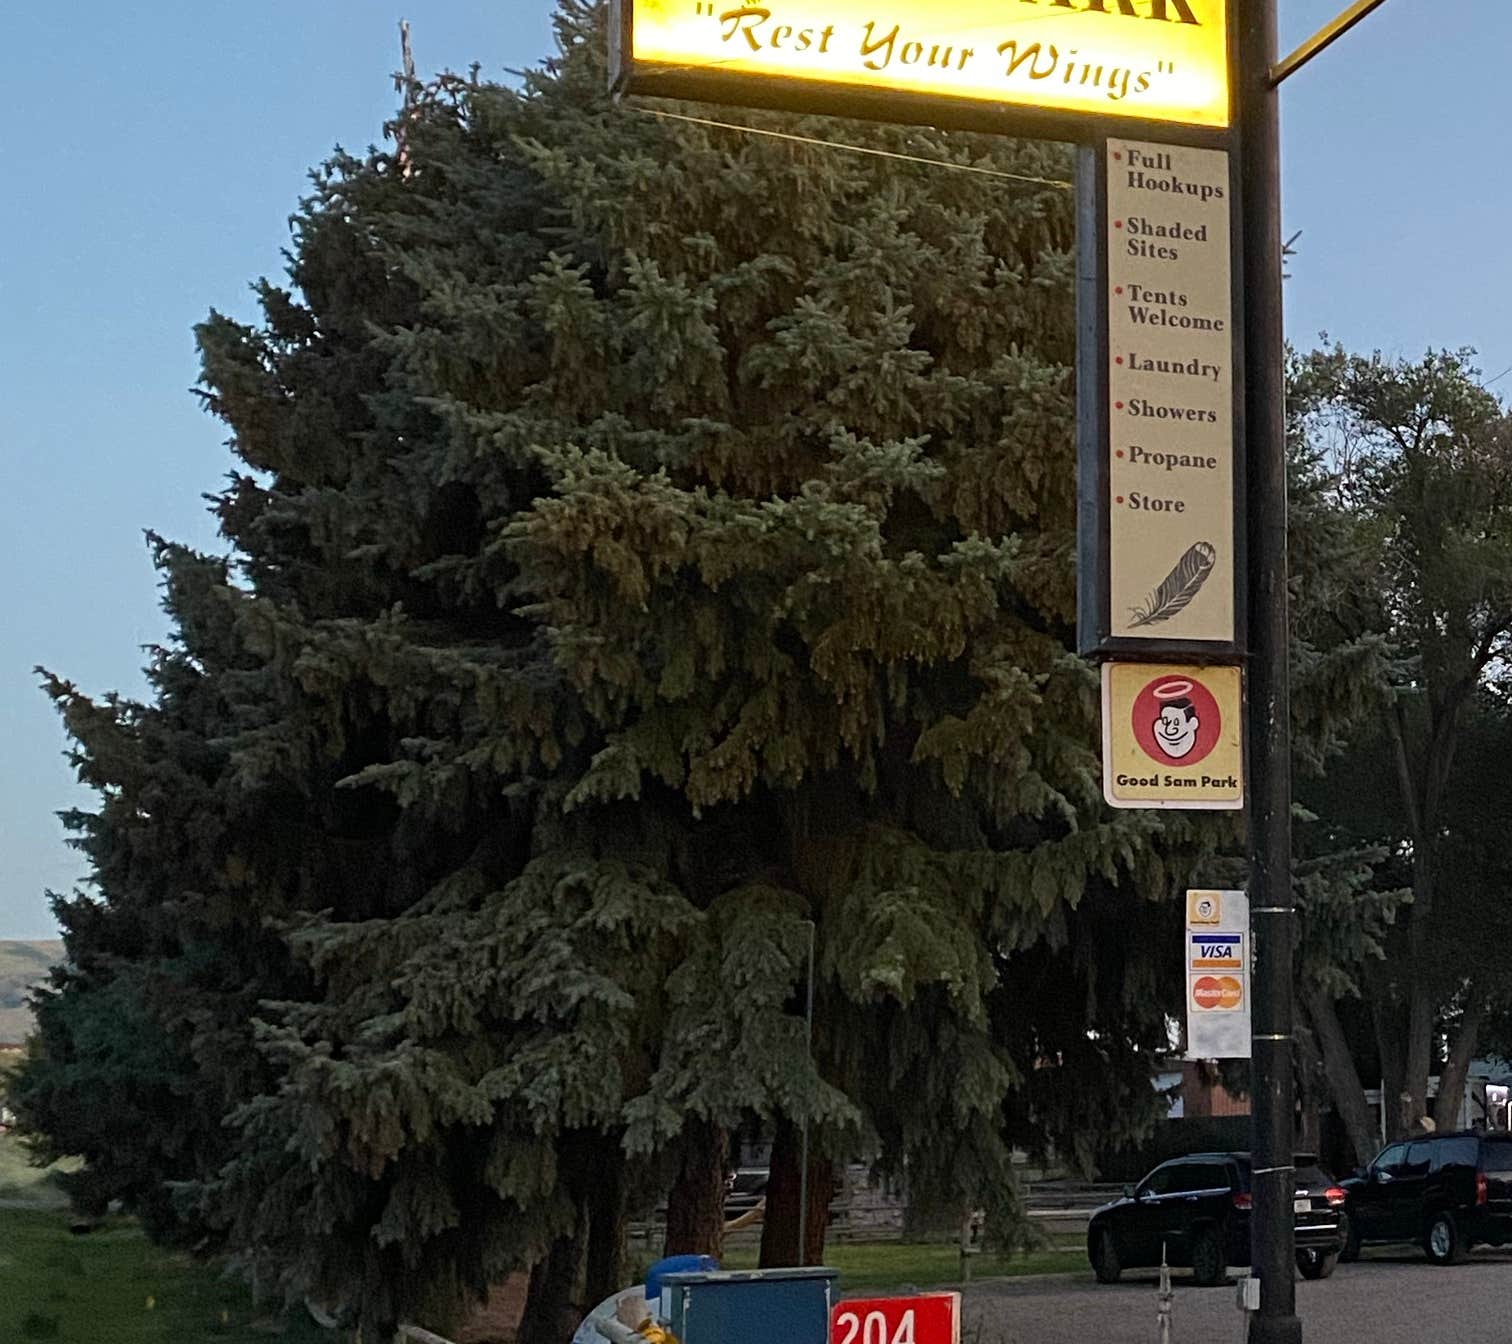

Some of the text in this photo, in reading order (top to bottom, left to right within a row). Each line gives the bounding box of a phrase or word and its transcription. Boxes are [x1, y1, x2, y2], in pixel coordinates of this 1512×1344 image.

[859, 20, 975, 72] Your
[1127, 149, 1171, 171] Full
[1127, 171, 1224, 202] Hookups
[1127, 217, 1207, 242] Shaded
[1127, 238, 1178, 260] Sites
[1128, 284, 1188, 306] Tents
[1128, 306, 1224, 331] Welcome
[1128, 353, 1221, 381] Laundry
[1128, 399, 1217, 422] Showers
[1128, 446, 1217, 471] Propane
[1128, 492, 1185, 512] Store
[1116, 774, 1237, 788] Good Sam Park
[1201, 945, 1232, 958] VISA
